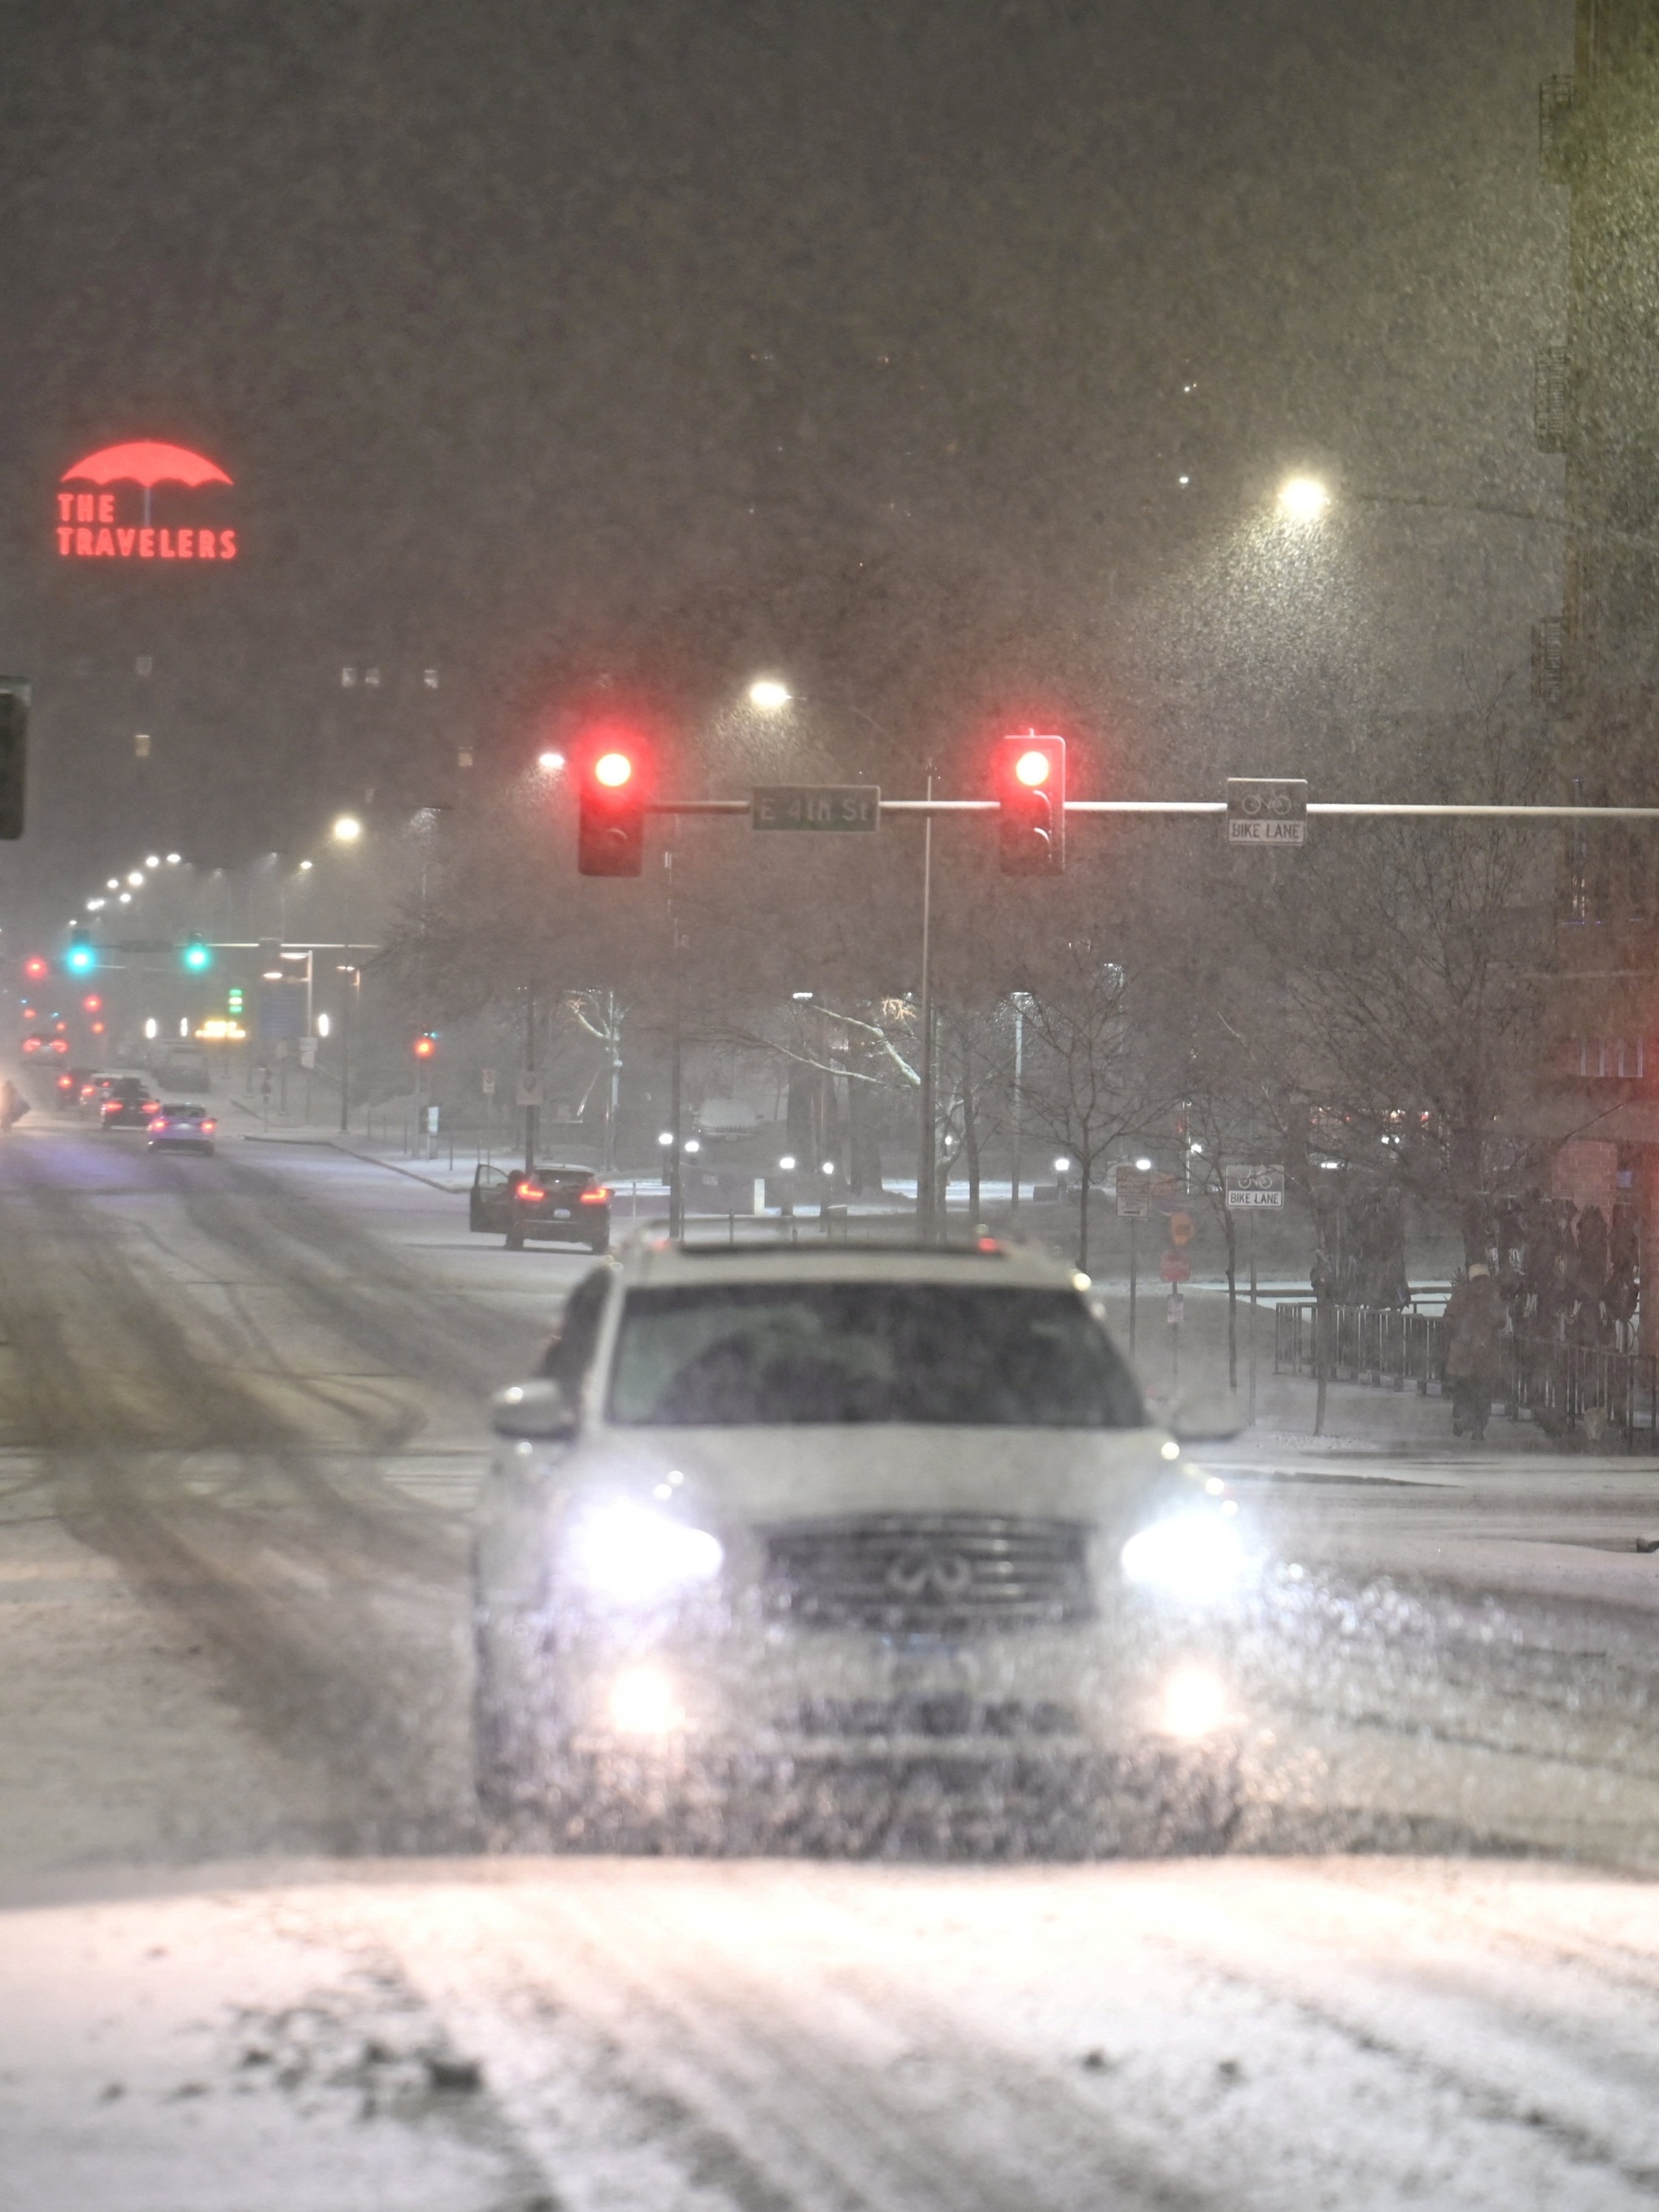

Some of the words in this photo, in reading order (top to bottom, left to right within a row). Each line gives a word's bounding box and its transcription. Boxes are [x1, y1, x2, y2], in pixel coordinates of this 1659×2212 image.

[58, 494, 115, 523] THE
[57, 527, 237, 559] TRAVELERS
[1232, 823, 1261, 838] BIKE
[1266, 823, 1300, 838] LANE
[1230, 1192, 1251, 1204] BIKE
[1254, 1193, 1279, 1204] LANE
